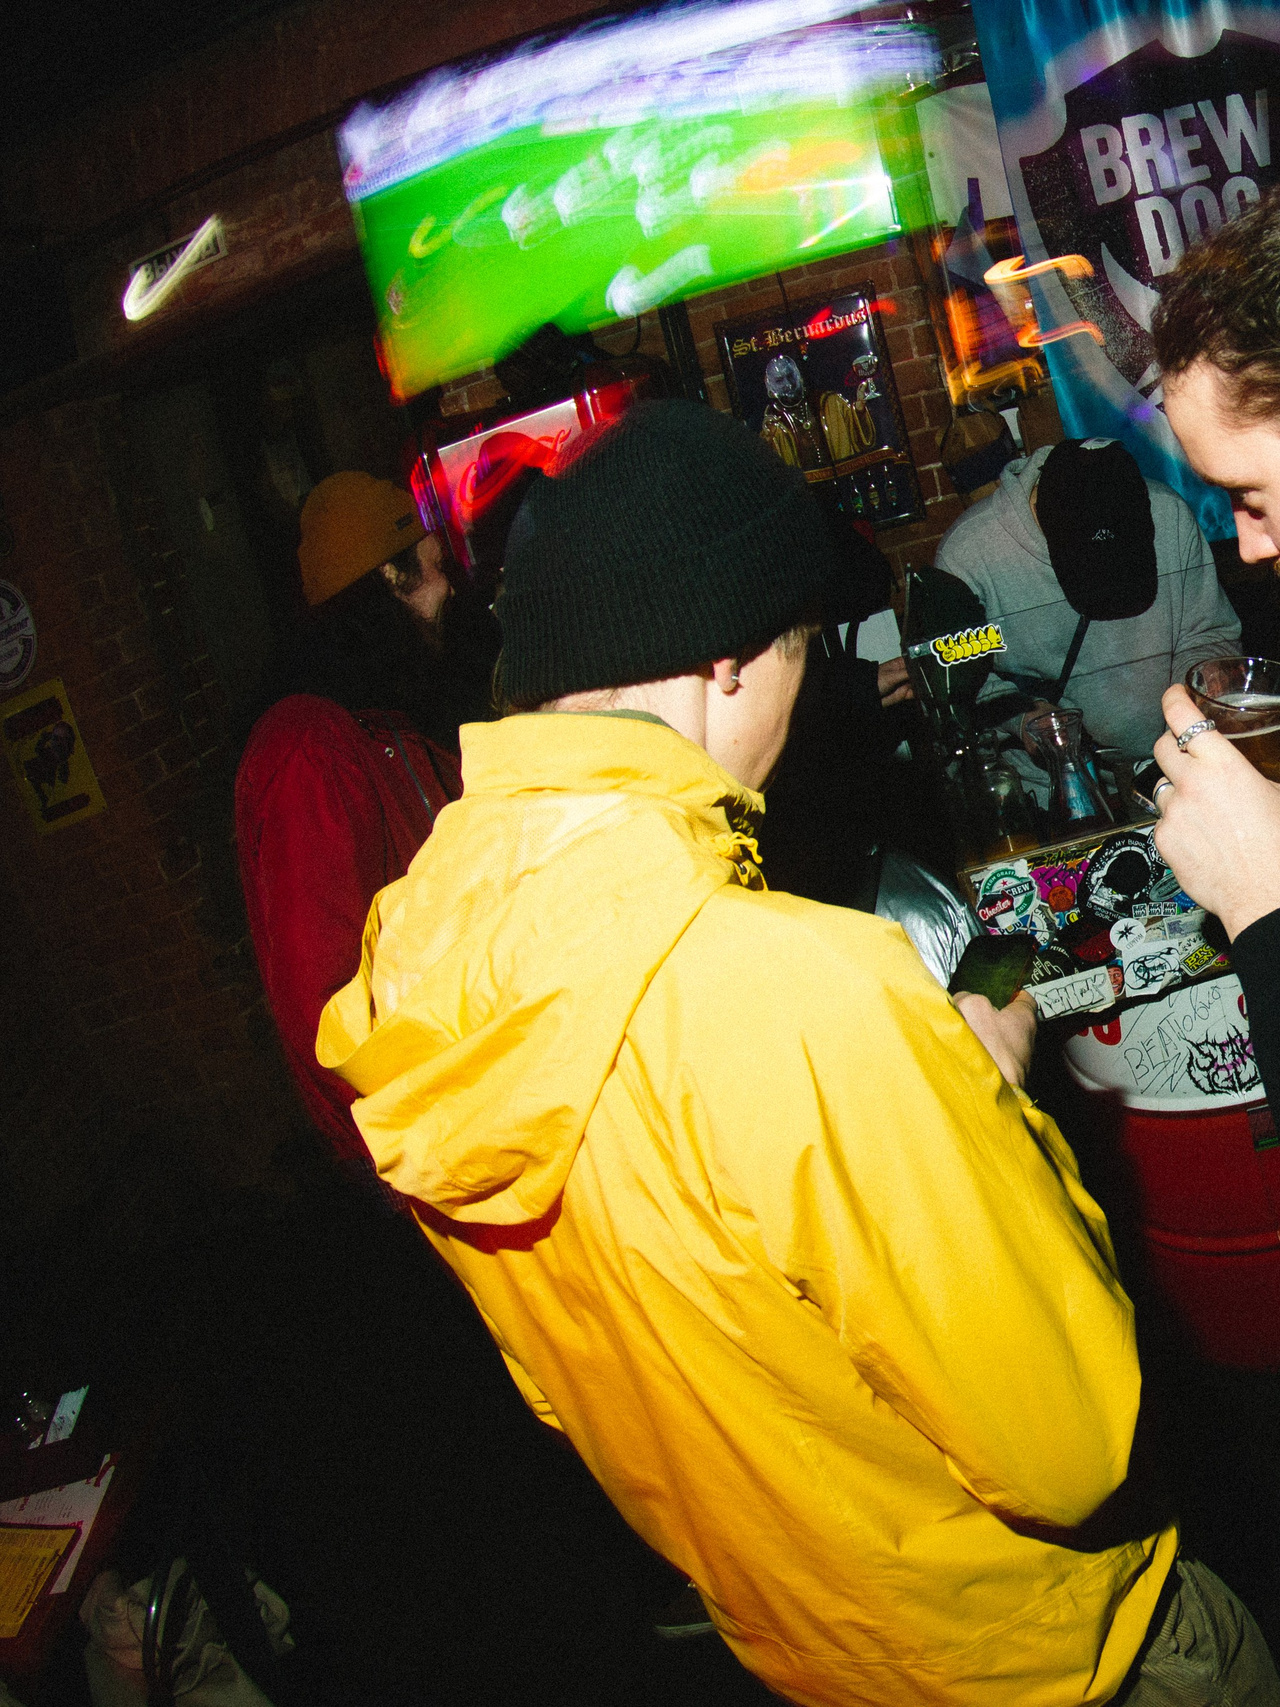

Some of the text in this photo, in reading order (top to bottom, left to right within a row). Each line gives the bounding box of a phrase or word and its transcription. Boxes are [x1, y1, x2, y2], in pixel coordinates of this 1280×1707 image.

[1080, 88, 1271, 206] BREW
[732, 306, 866, 358] St. Bernardus
[1115, 839, 1126, 848] MY
